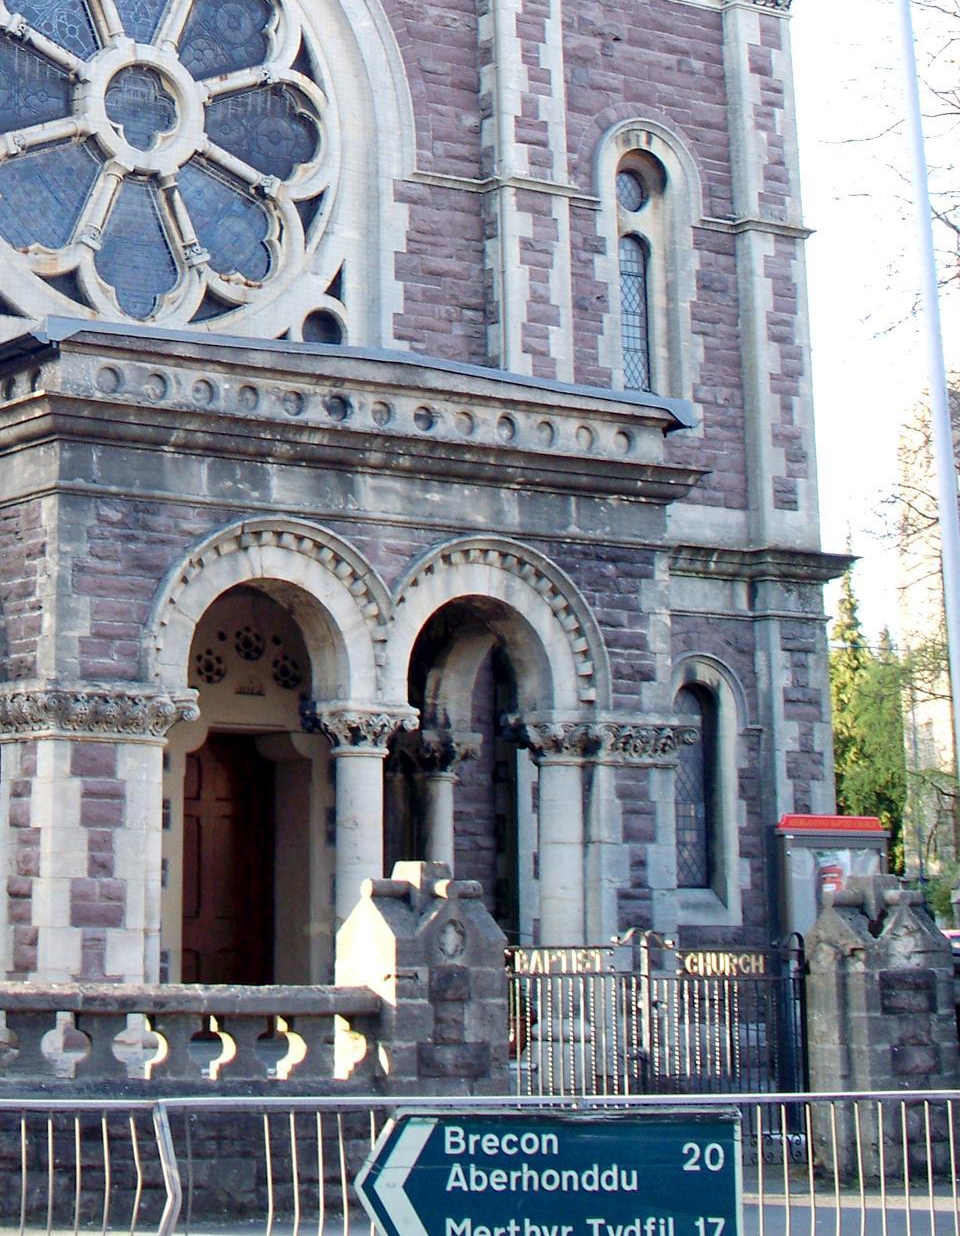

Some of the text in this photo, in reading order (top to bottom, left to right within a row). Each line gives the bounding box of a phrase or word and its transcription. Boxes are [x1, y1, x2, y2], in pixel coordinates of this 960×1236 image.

[514, 949, 764, 976] BAPTIST CHURCH
[444, 1125, 724, 1172] Brecon 20
[445, 1163, 638, 1192] Aberhonddu
[695, 1217, 725, 1236] 17
